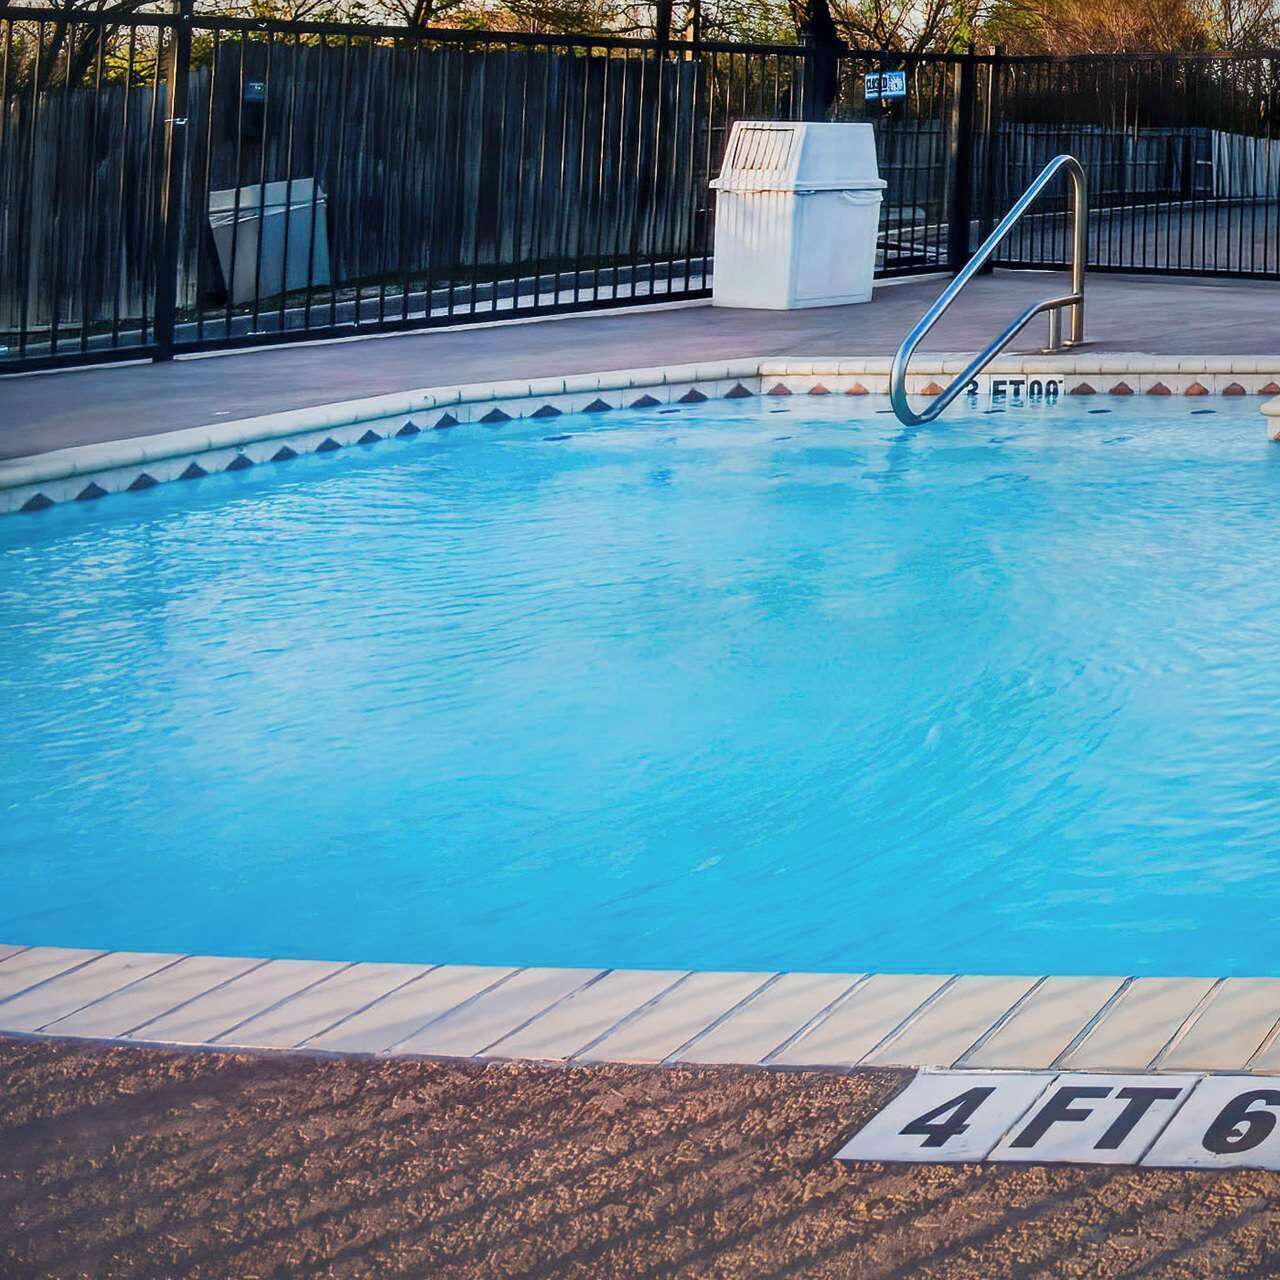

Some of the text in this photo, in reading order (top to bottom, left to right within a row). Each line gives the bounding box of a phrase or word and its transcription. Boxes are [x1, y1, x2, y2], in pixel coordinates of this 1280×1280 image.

[992, 380, 1025, 397] FT
[898, 1086, 997, 1148] 4
[1009, 1086, 1184, 1150] FT
